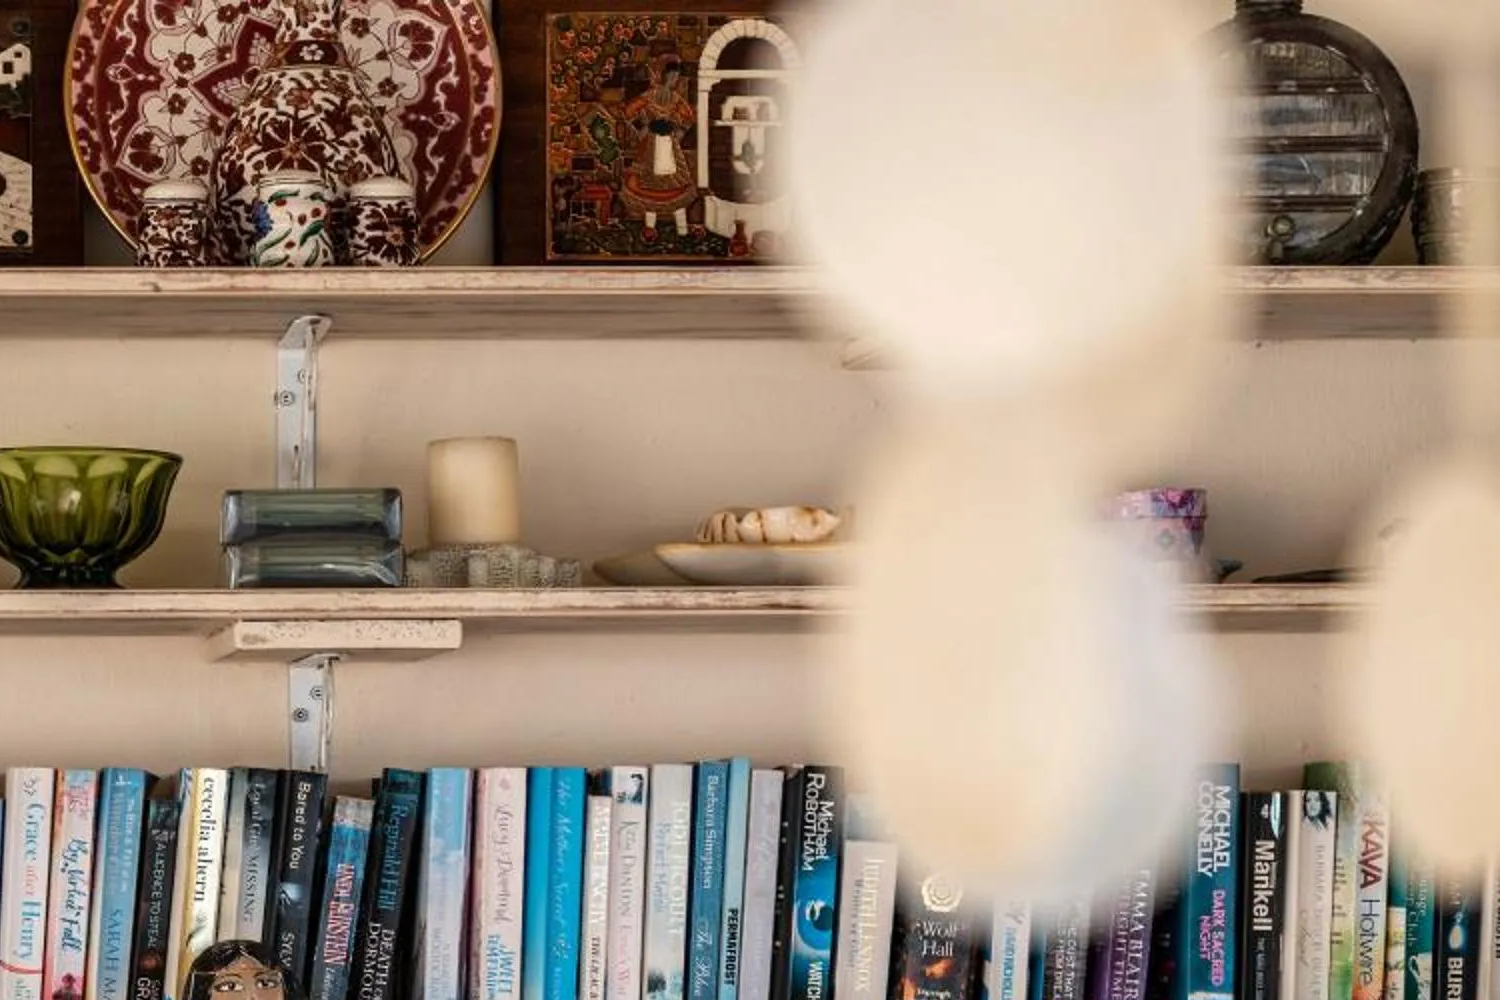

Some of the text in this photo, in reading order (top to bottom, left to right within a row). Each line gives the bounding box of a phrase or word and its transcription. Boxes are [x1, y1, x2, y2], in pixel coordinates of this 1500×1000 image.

[192, 776, 217, 903] cecelia ahern
[288, 780, 312, 872] Bared to You
[377, 802, 410, 912] Reginald Hill
[701, 775, 721, 890] Barbara Simpson
[801, 772, 827, 873] ROBOTHAM
[818, 800, 836, 861] Michael
[1196, 780, 1213, 878] CONNELLY
[1214, 784, 1231, 874] MICHAEL
[13, 803, 47, 961] Grace after Henry
[147, 851, 165, 951] LICENCE STEAL
[243, 854, 260, 925] MISSING
[668, 856, 688, 936] PICOULT
[860, 857, 886, 921] JUDITH
[1251, 839, 1276, 932] Mankell
[1358, 818, 1383, 986] KAVA Hotwire
[62, 915, 87, 953] Fall
[103, 908, 121, 971] SARAH
[377, 928, 397, 985] DEATH
[723, 907, 740, 987] PERMAFROST
[854, 922, 880, 995] LENNOX
[921, 939, 954, 957] Hall
[1122, 940, 1144, 1000] BLAIR
[1198, 915, 1212, 961] NIGHT
[1209, 888, 1226, 987] DARK SACRED
[693, 959, 711, 997] Blue
[1110, 960, 1124, 1000] TIME
